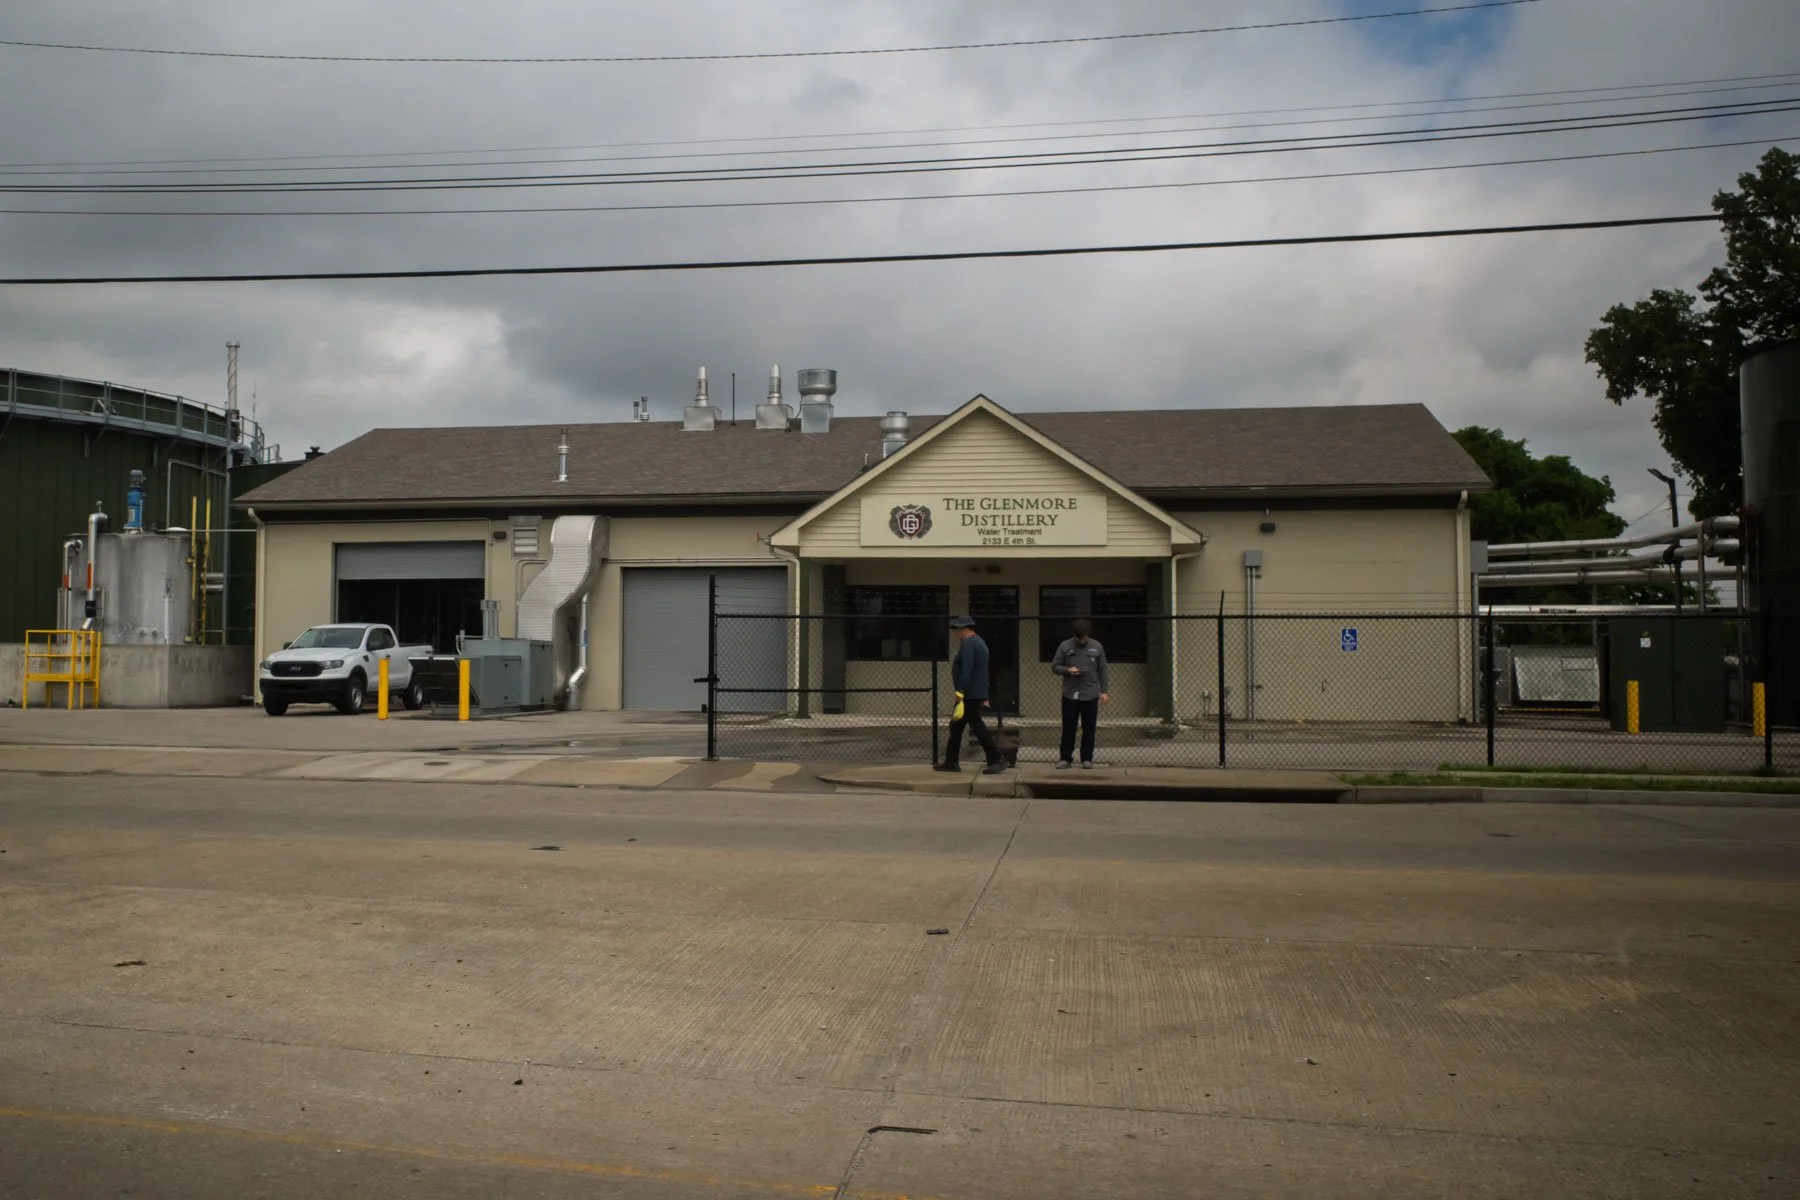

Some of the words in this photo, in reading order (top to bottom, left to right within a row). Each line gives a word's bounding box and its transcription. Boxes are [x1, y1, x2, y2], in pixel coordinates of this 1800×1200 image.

[943, 498, 975, 511] THE
[980, 498, 1078, 511] GLENMORE
[961, 513, 1059, 527] DISTILLERY
[977, 528, 1001, 536] Water
[1003, 528, 1042, 536] Treatment
[982, 537, 1002, 545] 2133
[1004, 537, 1010, 545] E
[1011, 537, 1024, 545] 4th
[1026, 537, 1037, 545] St.
